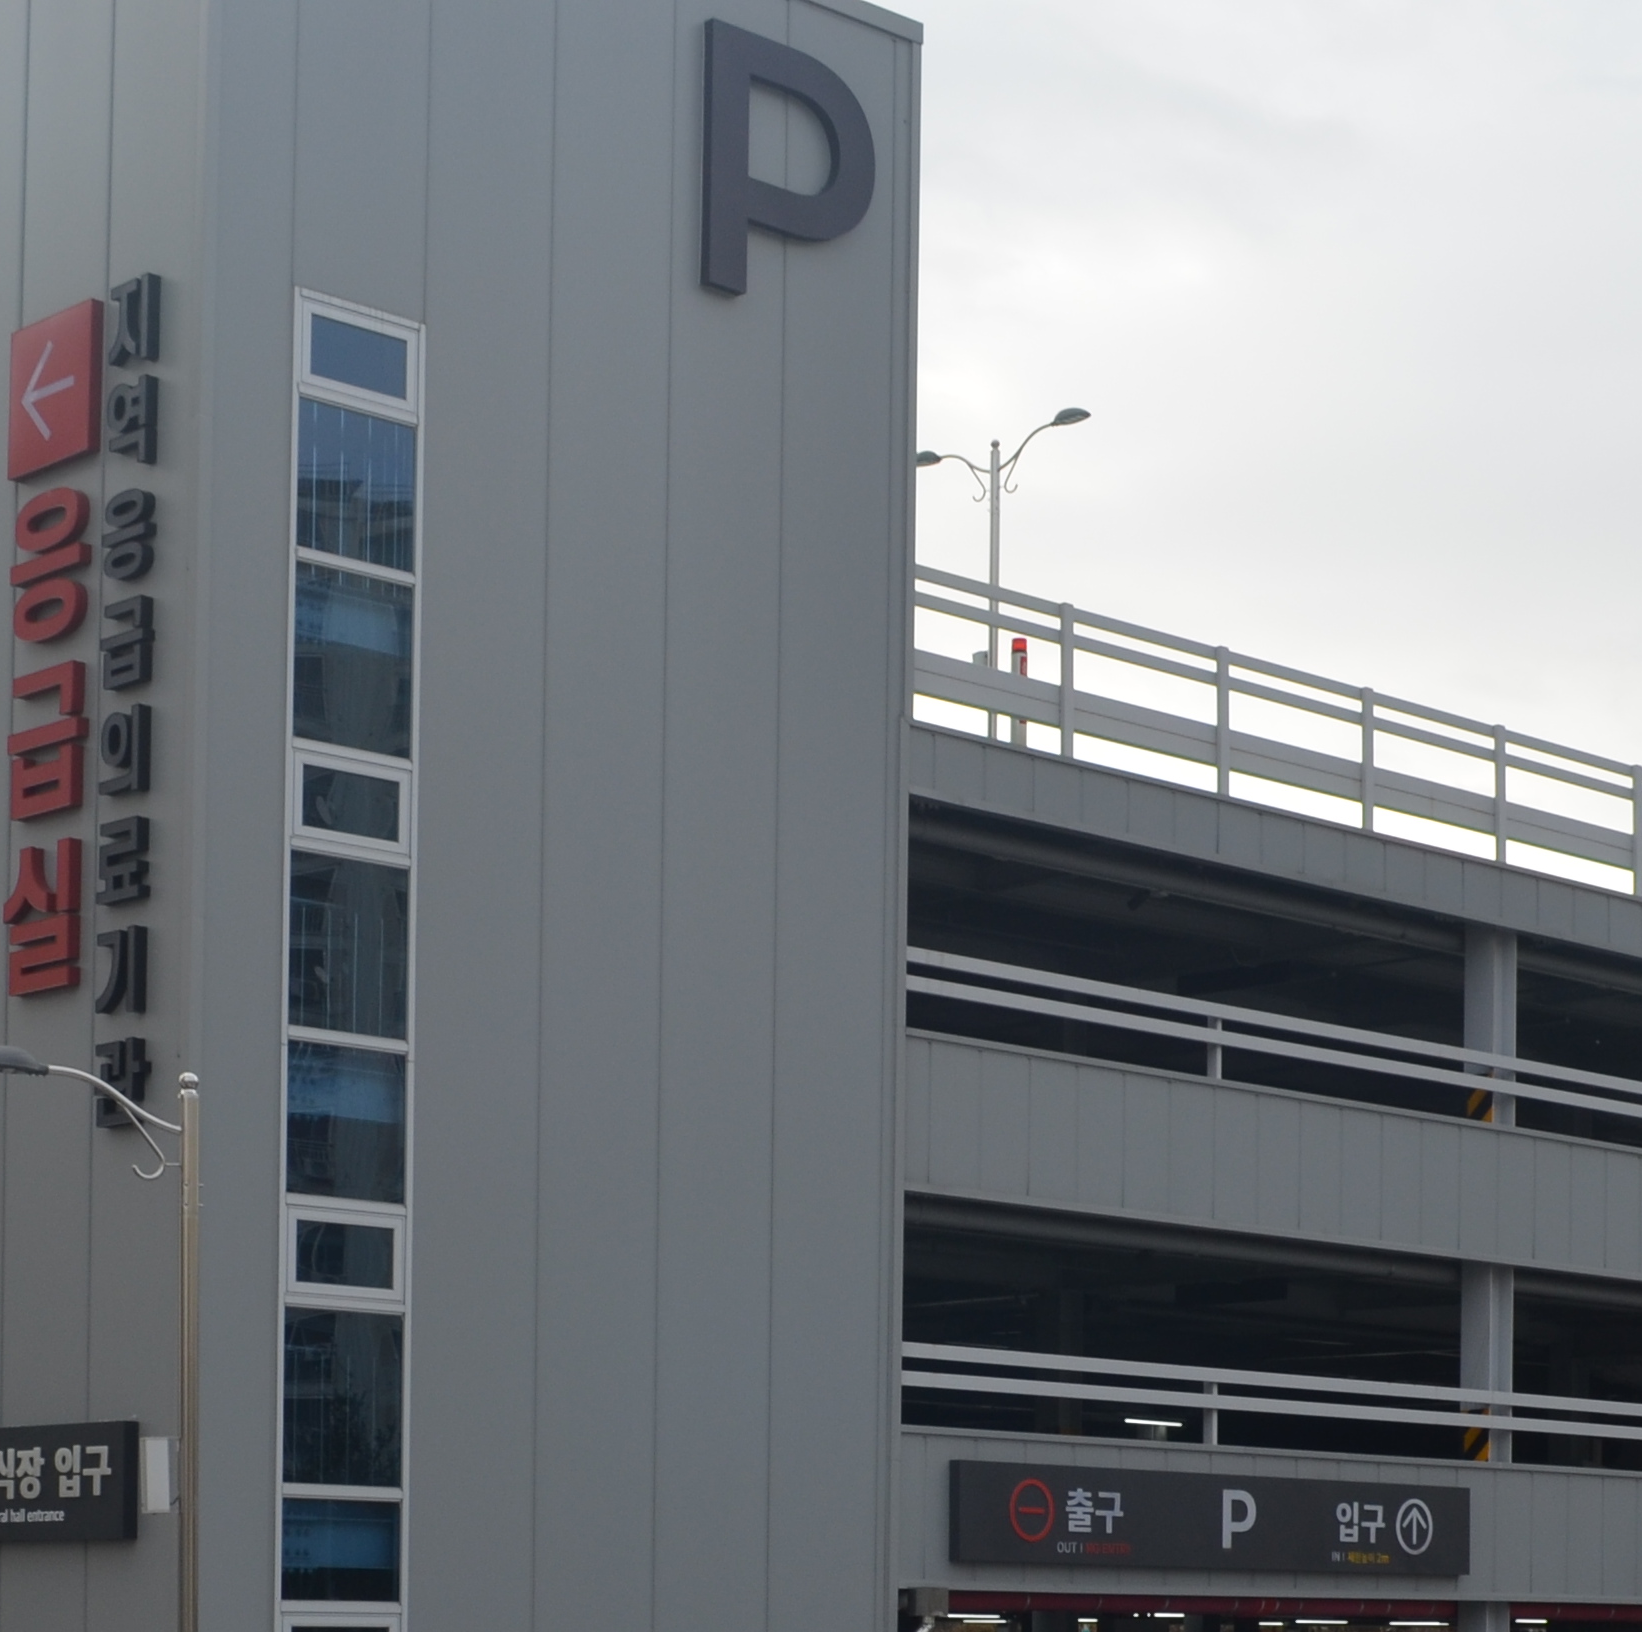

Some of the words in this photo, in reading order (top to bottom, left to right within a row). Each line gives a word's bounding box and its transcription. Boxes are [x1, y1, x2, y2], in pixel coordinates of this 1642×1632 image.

[700, 17, 876, 297] P
[3, 486, 92, 999] 응급실
[54, 1444, 112, 1498] 입구
[10, 1509, 25, 1523] hall
[27, 1508, 65, 1523] entrance
[1065, 1487, 1124, 1535] 출구
[1221, 1488, 1257, 1550] P
[1335, 1501, 1386, 1544] 입구
[1057, 1541, 1077, 1554] OUT
